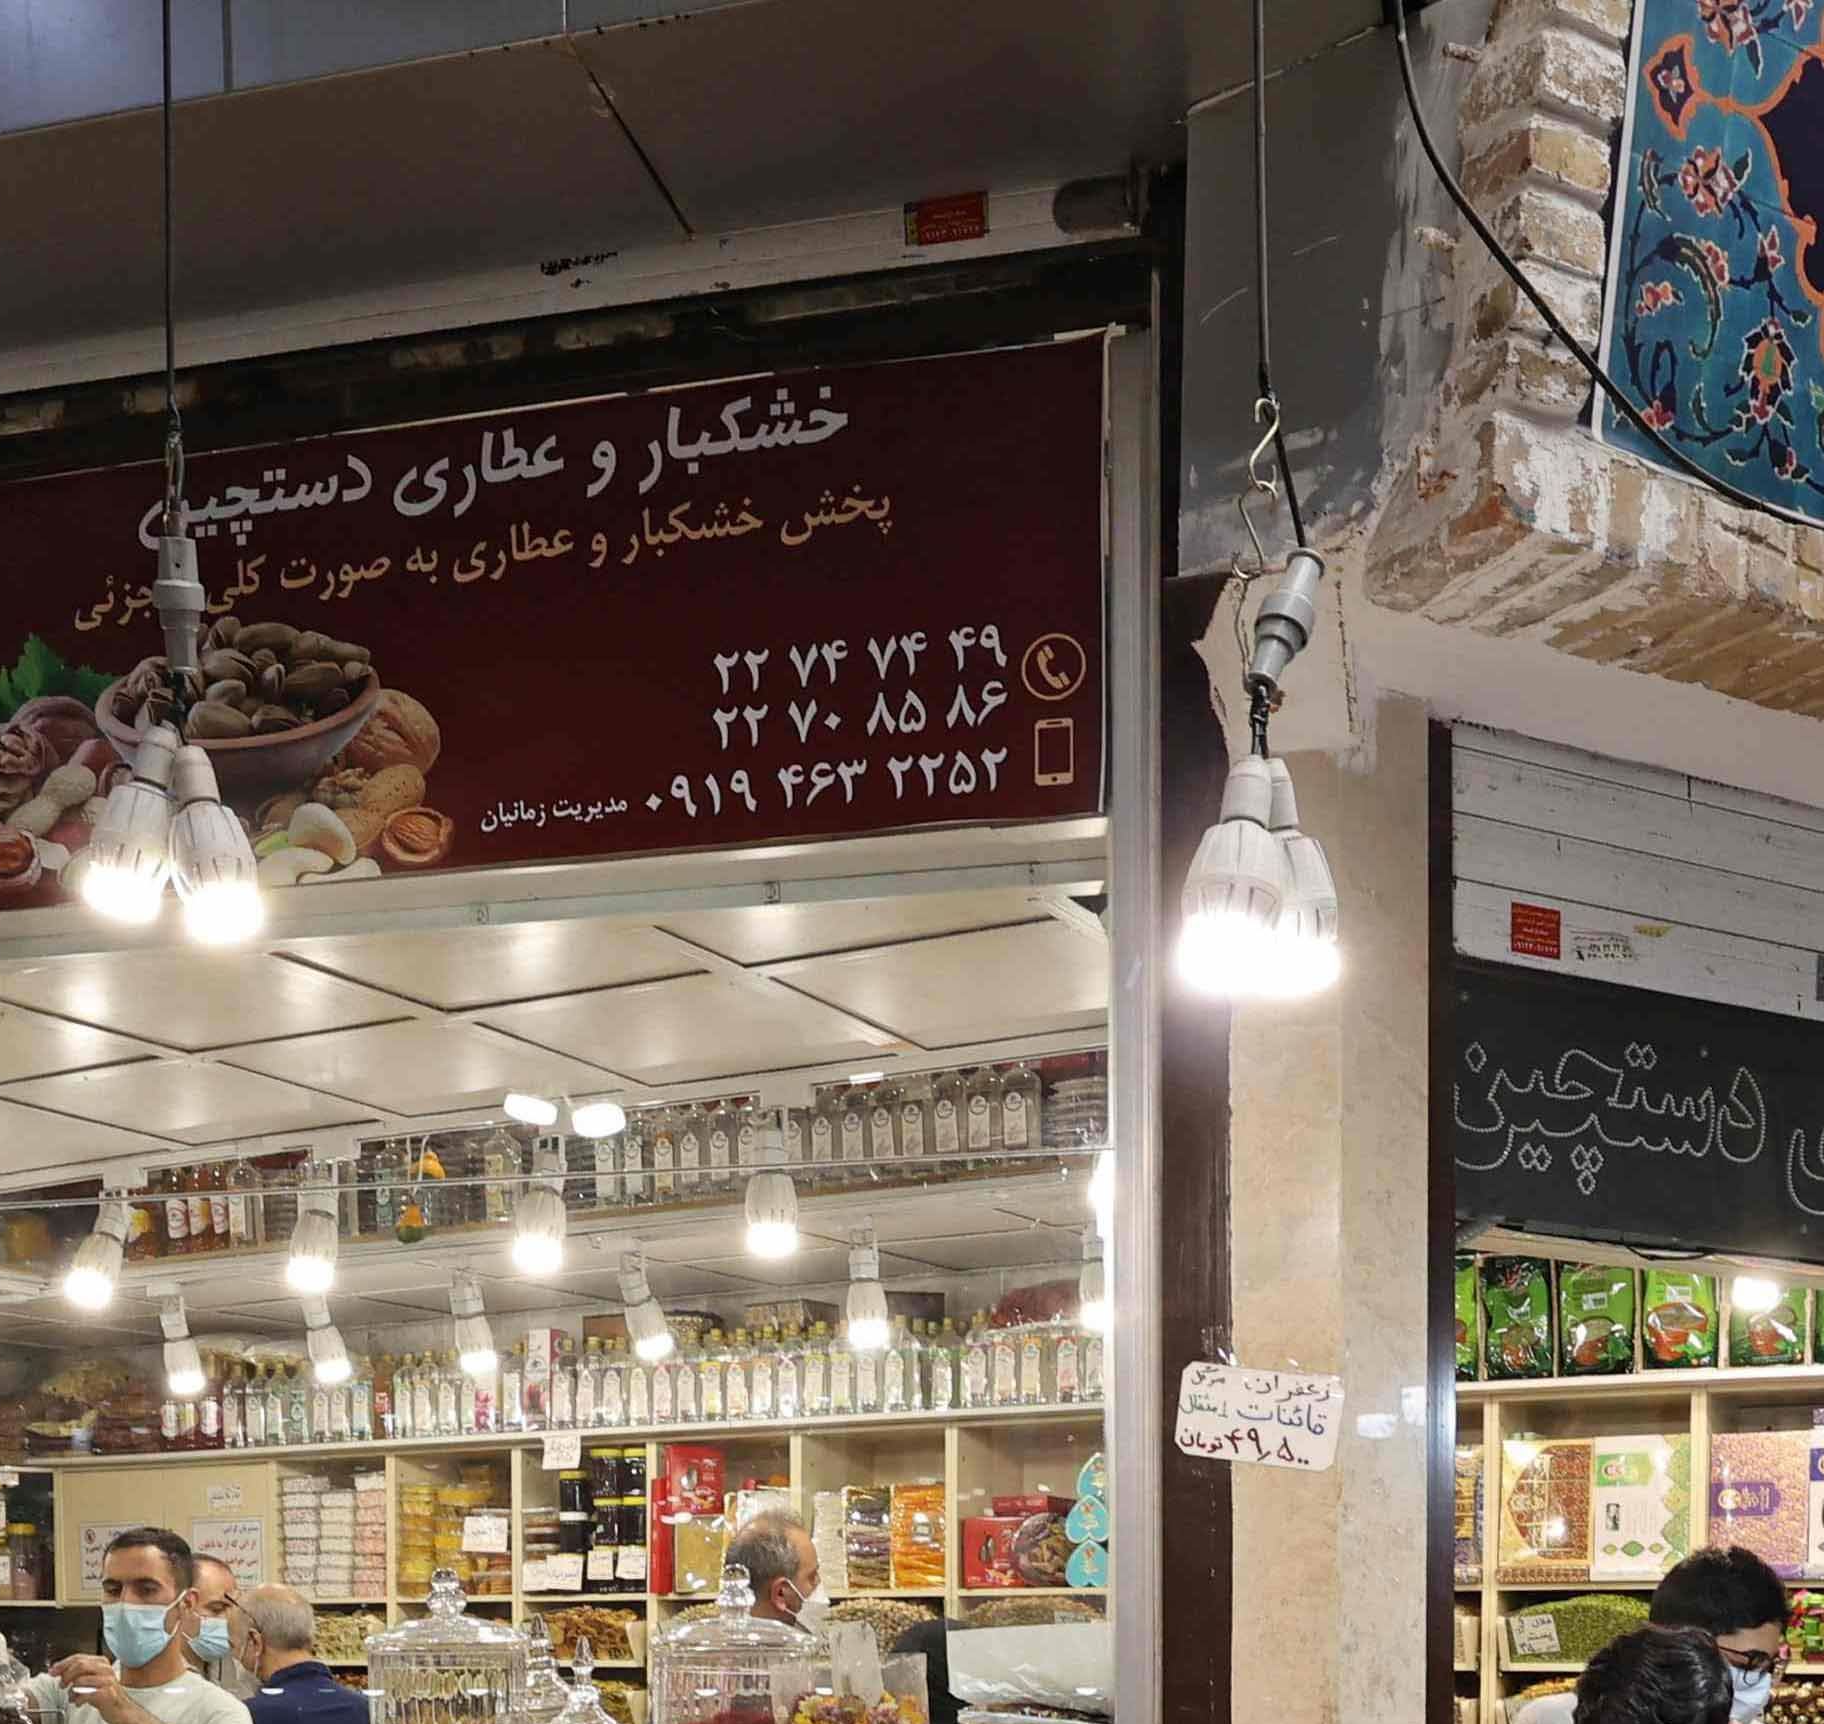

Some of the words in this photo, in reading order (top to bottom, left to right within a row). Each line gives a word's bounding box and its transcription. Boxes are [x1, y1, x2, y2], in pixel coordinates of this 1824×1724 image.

[587, 438, 617, 498] و
[638, 387, 850, 494] خشکبار
[393, 429, 566, 519] عطاری
[622, 500, 764, 568] خشکبار
[779, 484, 893, 547] پخش
[280, 554, 392, 602] صورت
[404, 545, 439, 577] به
[451, 522, 575, 584] عطاری
[590, 538, 609, 568] و
[479, 802, 547, 832] زمانیان
[551, 792, 628, 820] مدیریت
